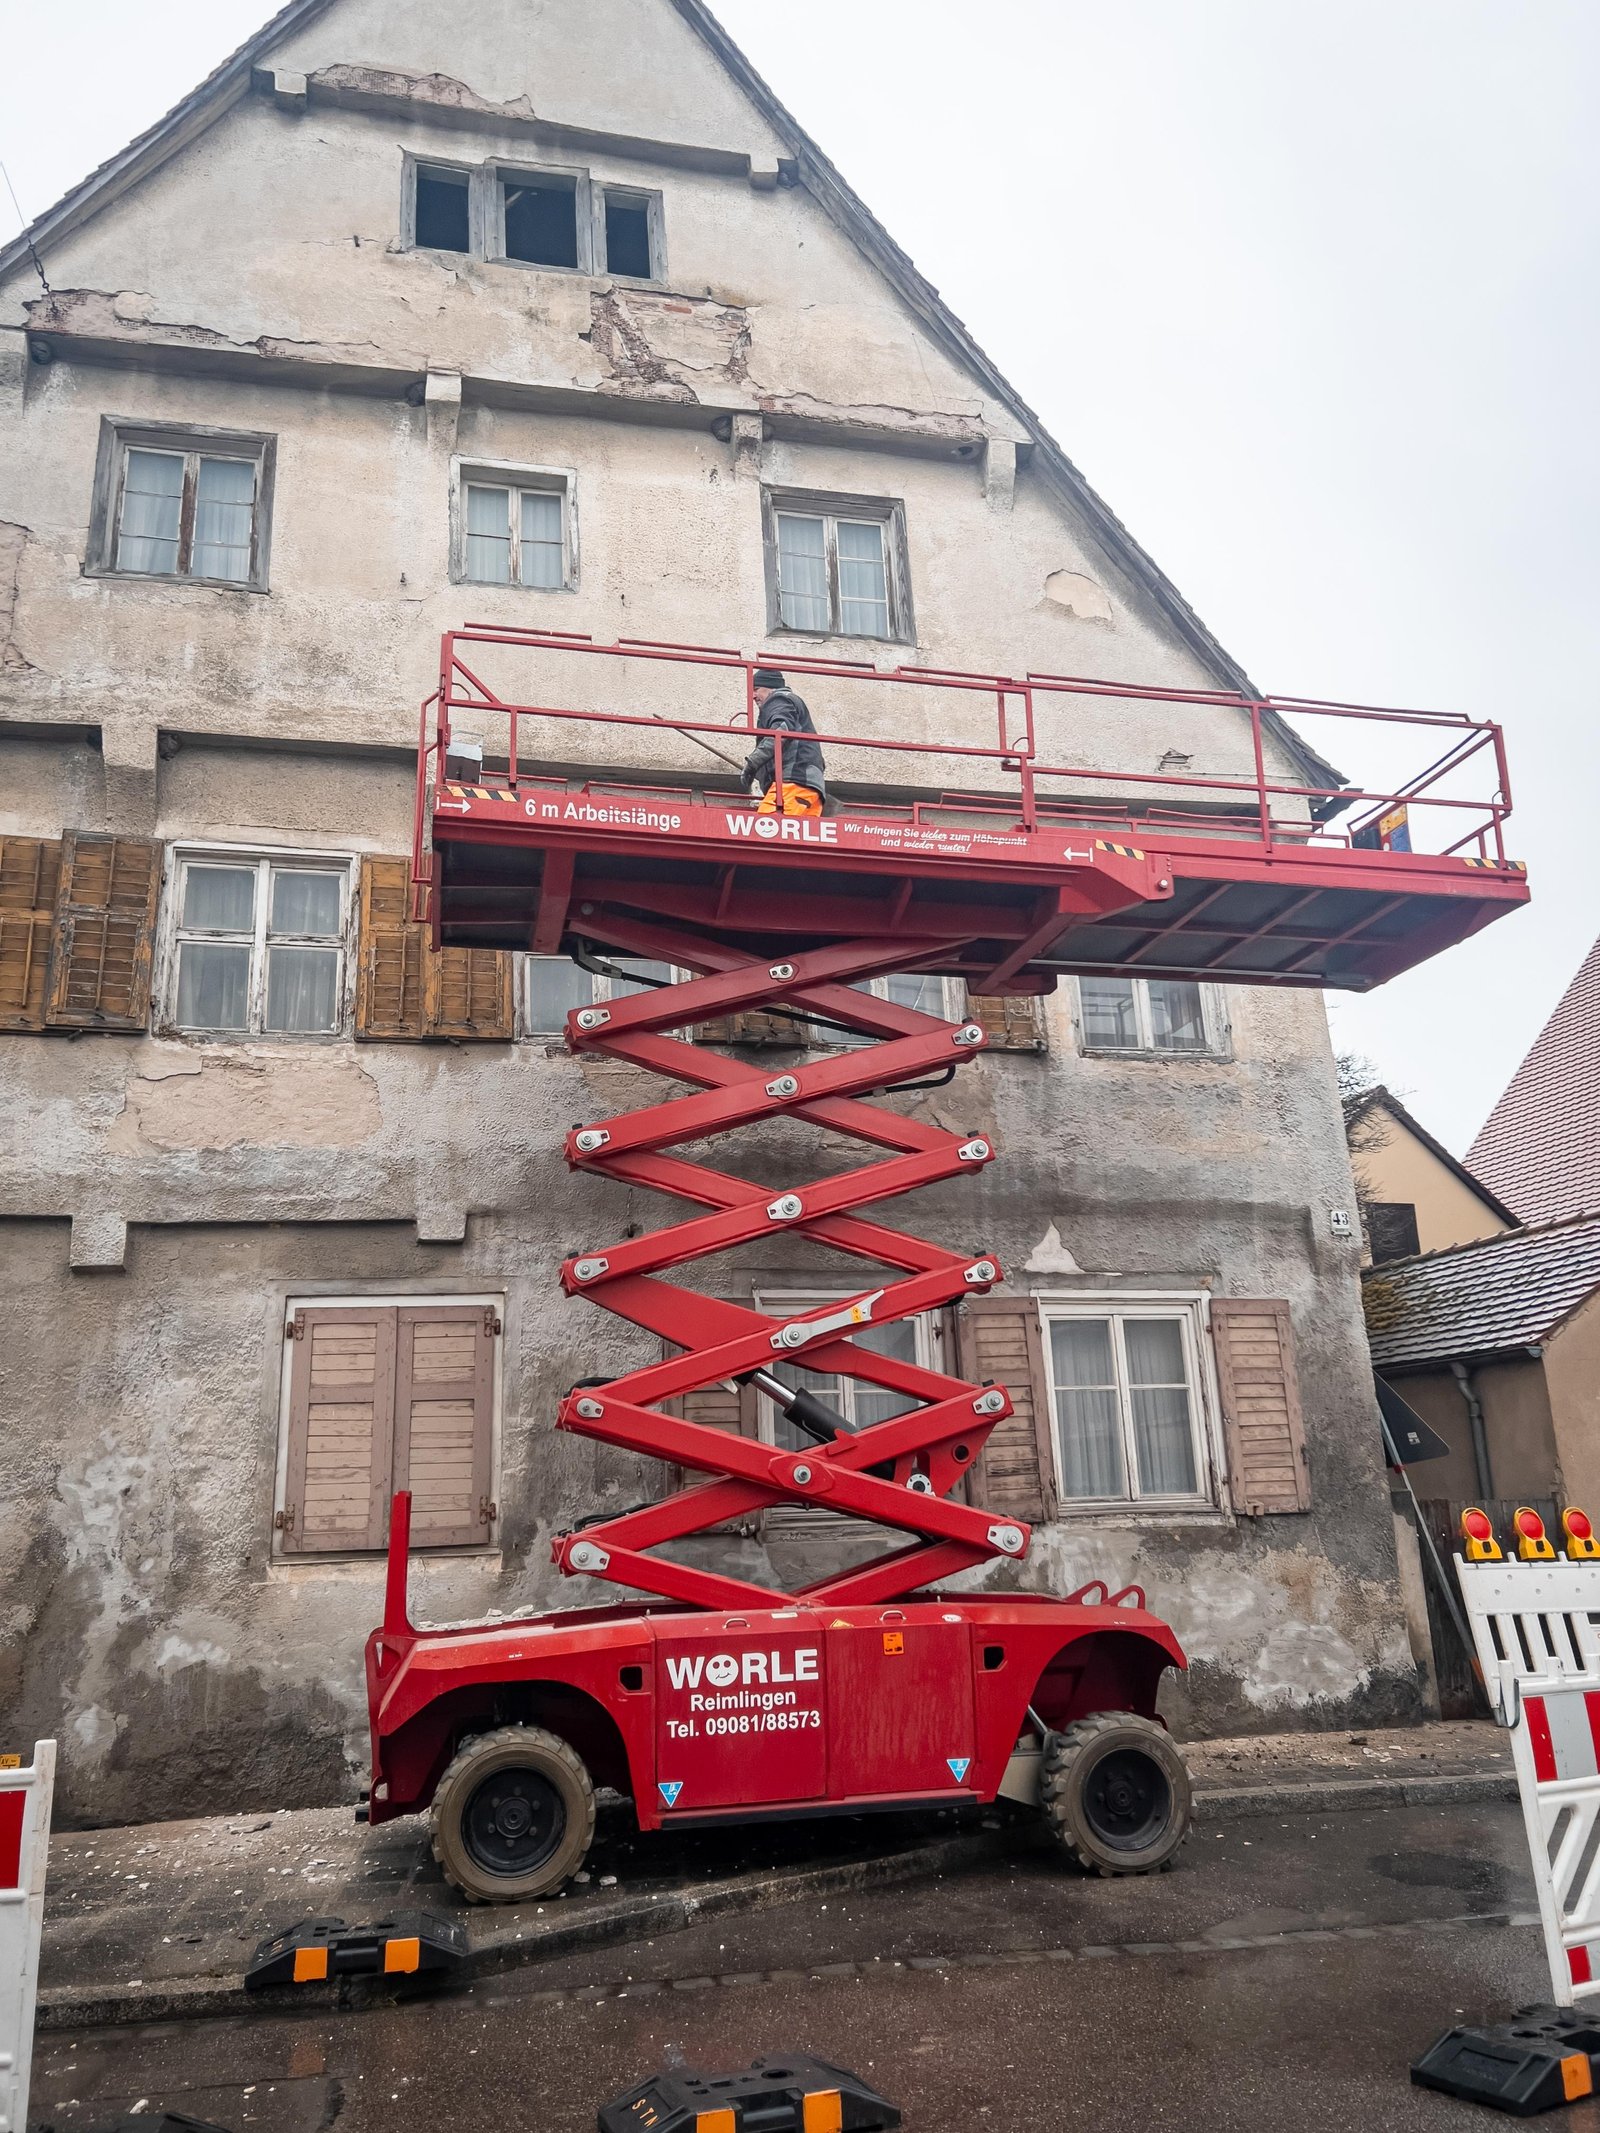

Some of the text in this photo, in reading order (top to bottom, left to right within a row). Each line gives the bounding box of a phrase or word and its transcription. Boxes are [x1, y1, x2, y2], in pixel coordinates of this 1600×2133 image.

[524, 798, 681, 832] 6 m Arbeitslänge
[844, 823, 1028, 846] Wir bringen Sie sicher zum Höhepunkt
[880, 838, 901, 847] und
[903, 840, 934, 850] wieder
[1332, 1212, 1349, 1226] 43
[690, 1690, 796, 1712] Reimlingen
[666, 1710, 821, 1739] Tel. 09081/88573
